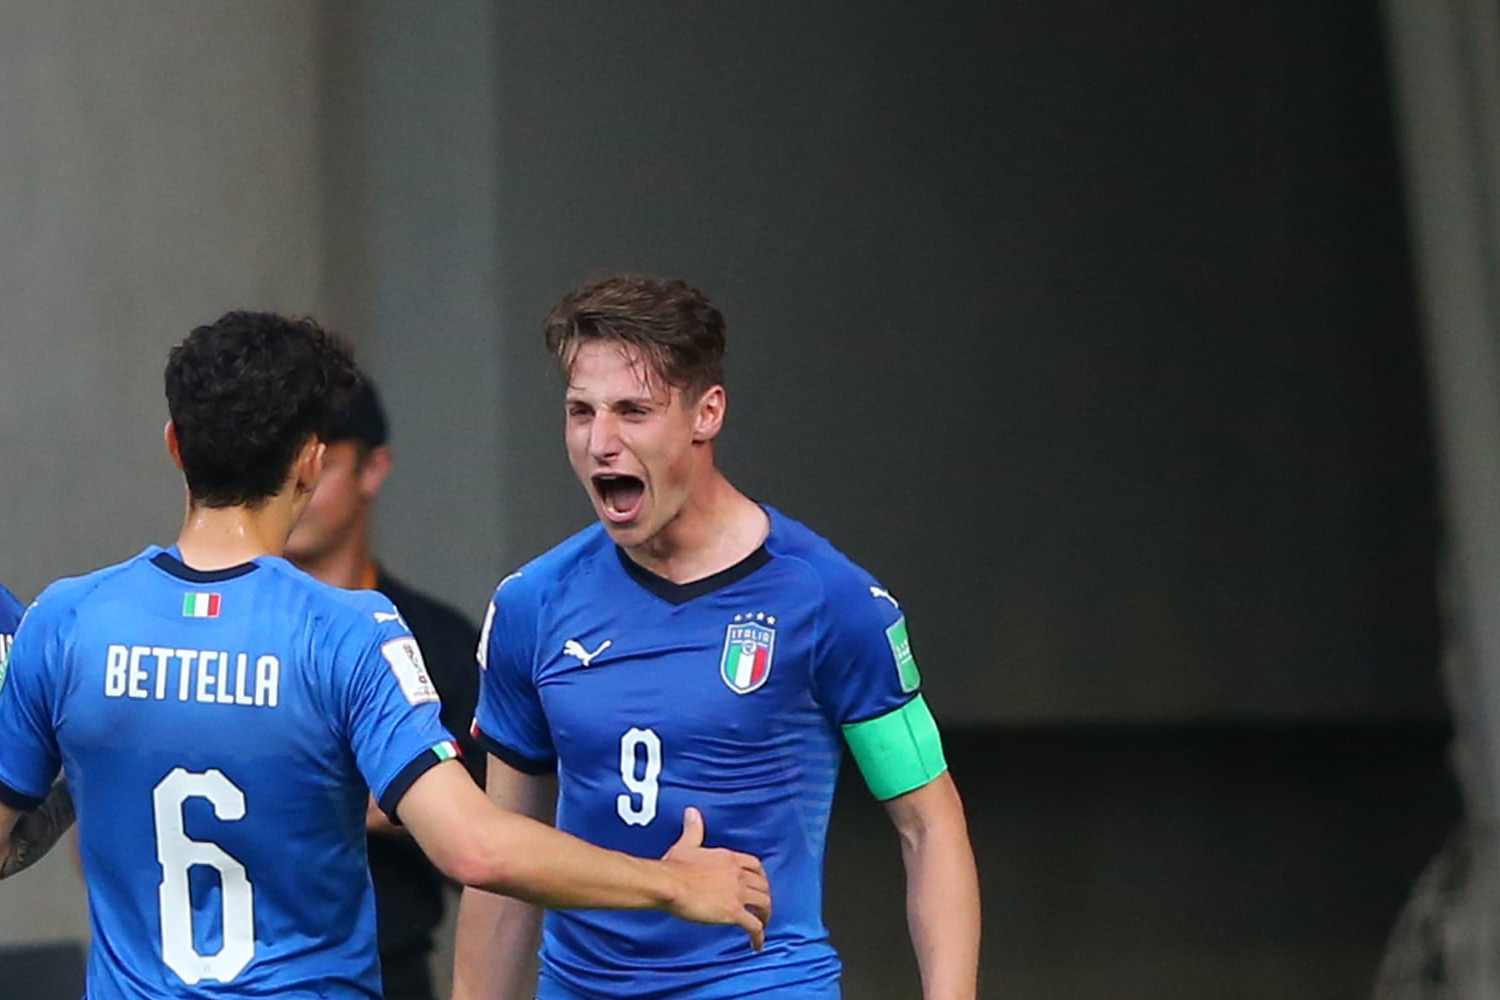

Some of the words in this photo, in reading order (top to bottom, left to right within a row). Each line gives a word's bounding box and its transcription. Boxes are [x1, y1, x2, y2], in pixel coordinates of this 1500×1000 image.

[731, 628, 770, 642] ITALIA
[104, 645, 281, 708] BETTELLA
[617, 727, 663, 827] 9
[153, 767, 255, 985] 6
